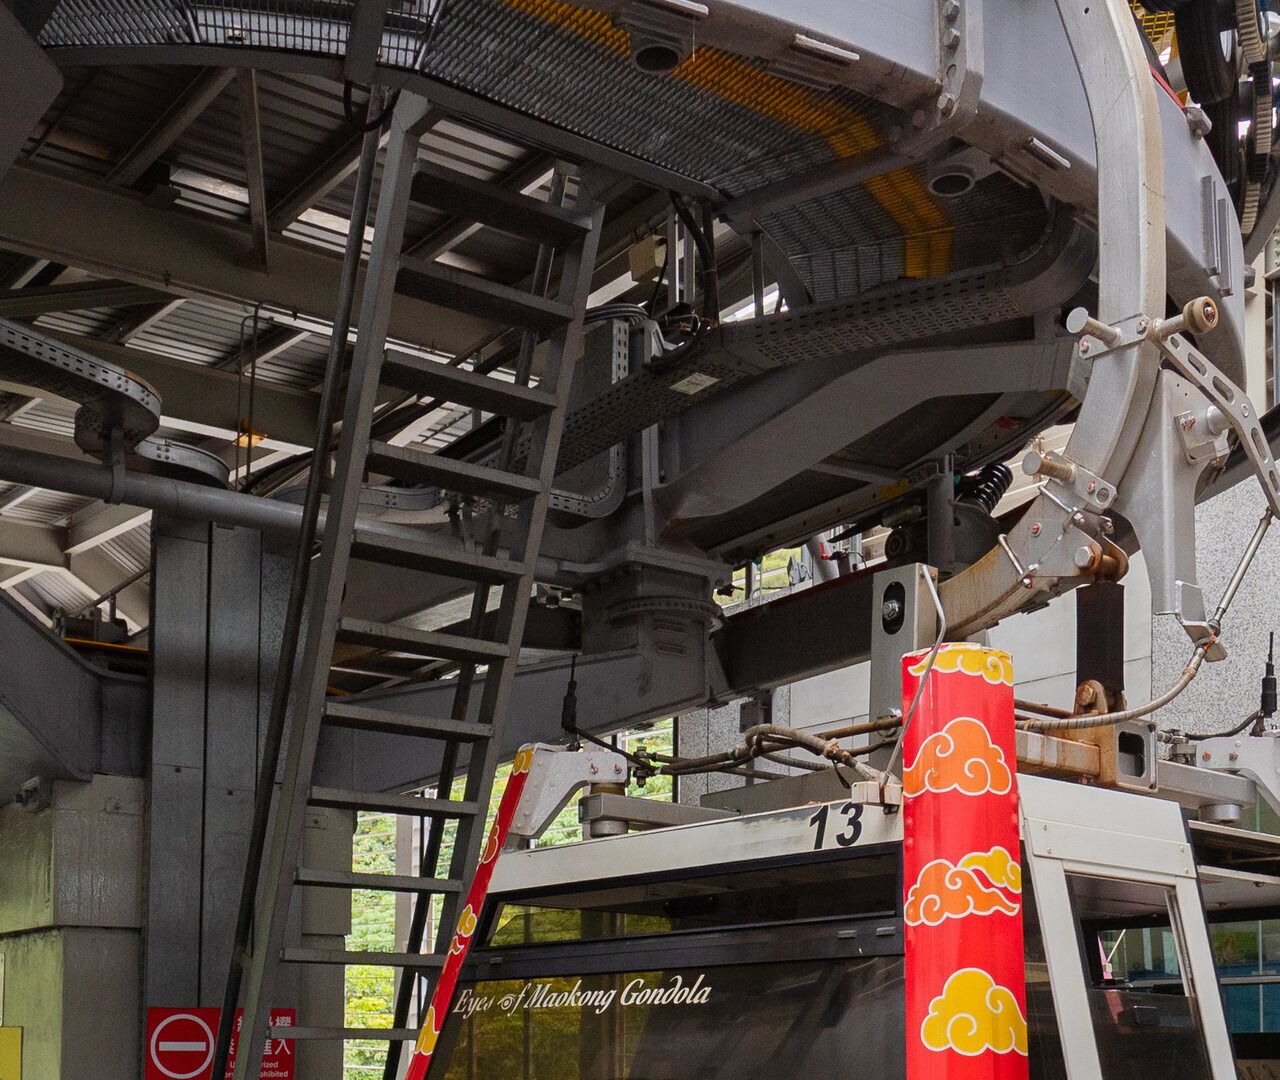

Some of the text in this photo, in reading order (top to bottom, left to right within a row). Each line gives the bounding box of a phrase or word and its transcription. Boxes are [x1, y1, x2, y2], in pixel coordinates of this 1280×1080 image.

[808, 801, 864, 851] 13
[453, 989, 493, 1019] Eyes
[523, 979, 617, 1014] Maokong
[620, 974, 713, 1006] Gondola
